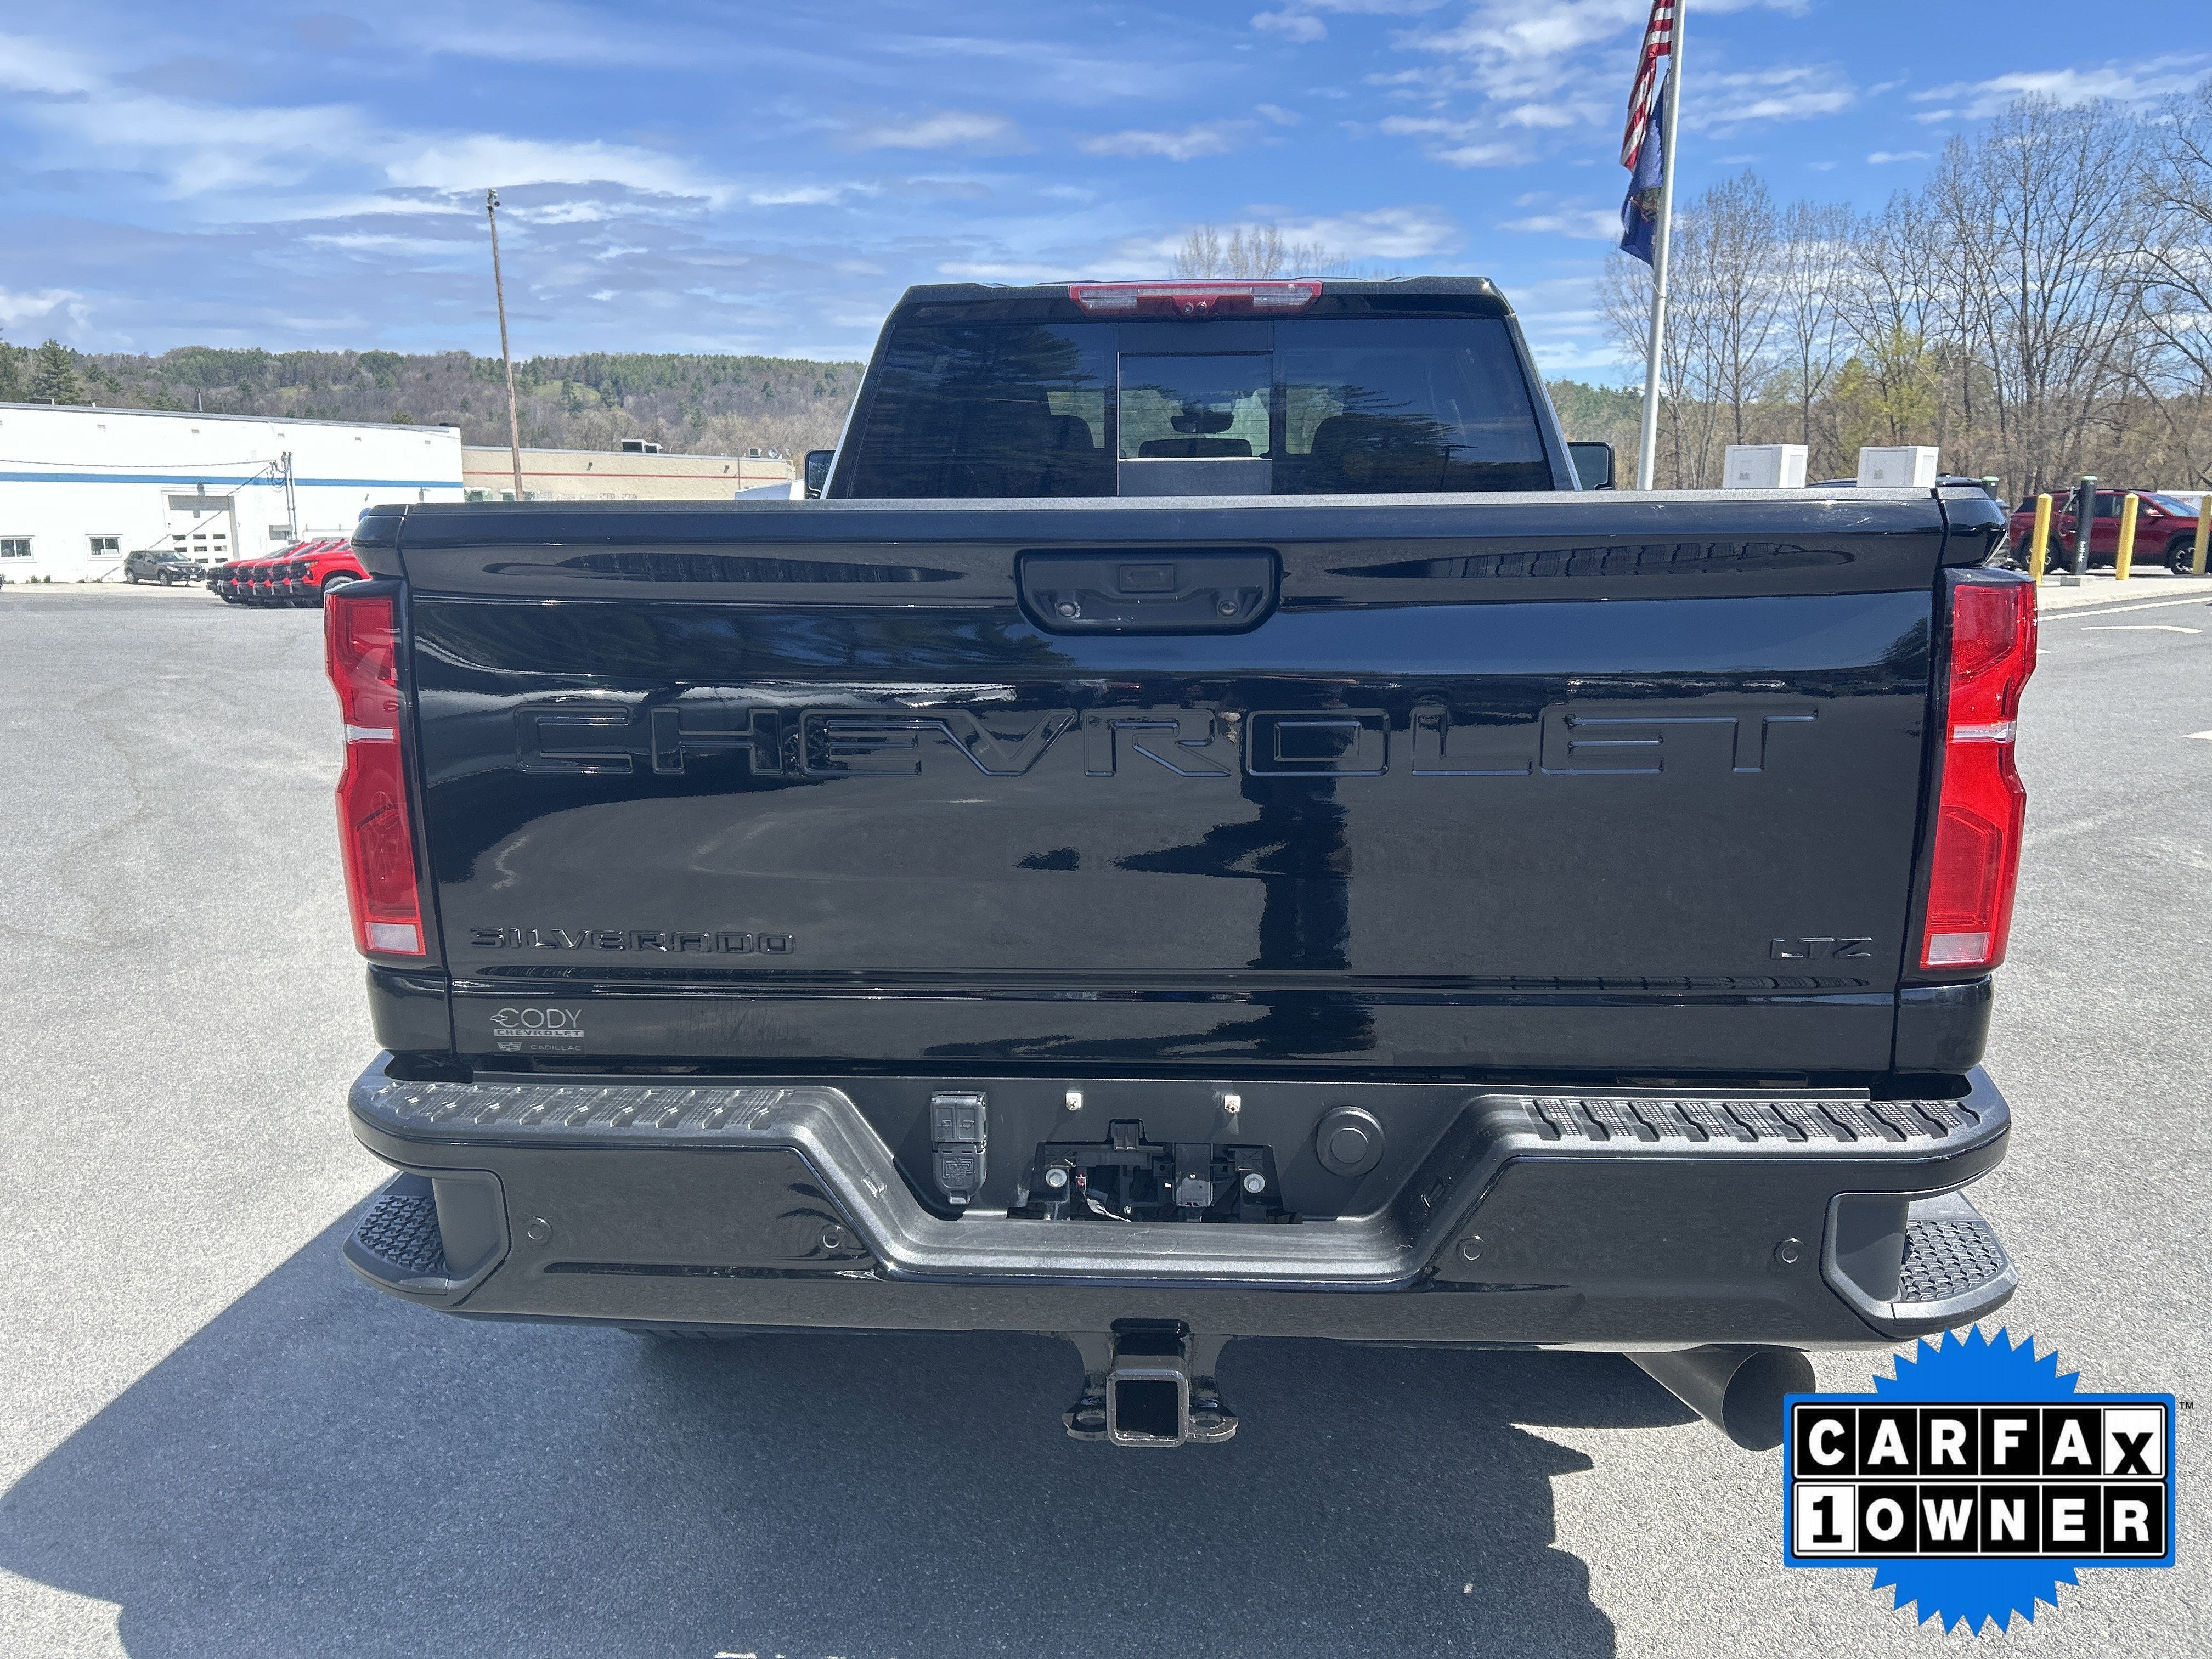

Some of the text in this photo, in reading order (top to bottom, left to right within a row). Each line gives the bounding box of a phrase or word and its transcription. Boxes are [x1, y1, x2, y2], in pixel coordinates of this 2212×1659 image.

[515, 703, 1819, 775] CHEVROLET
[470, 928, 795, 955] SILVERADO
[1770, 937, 1871, 960] LTZ
[492, 1008, 582, 1028] CODY
